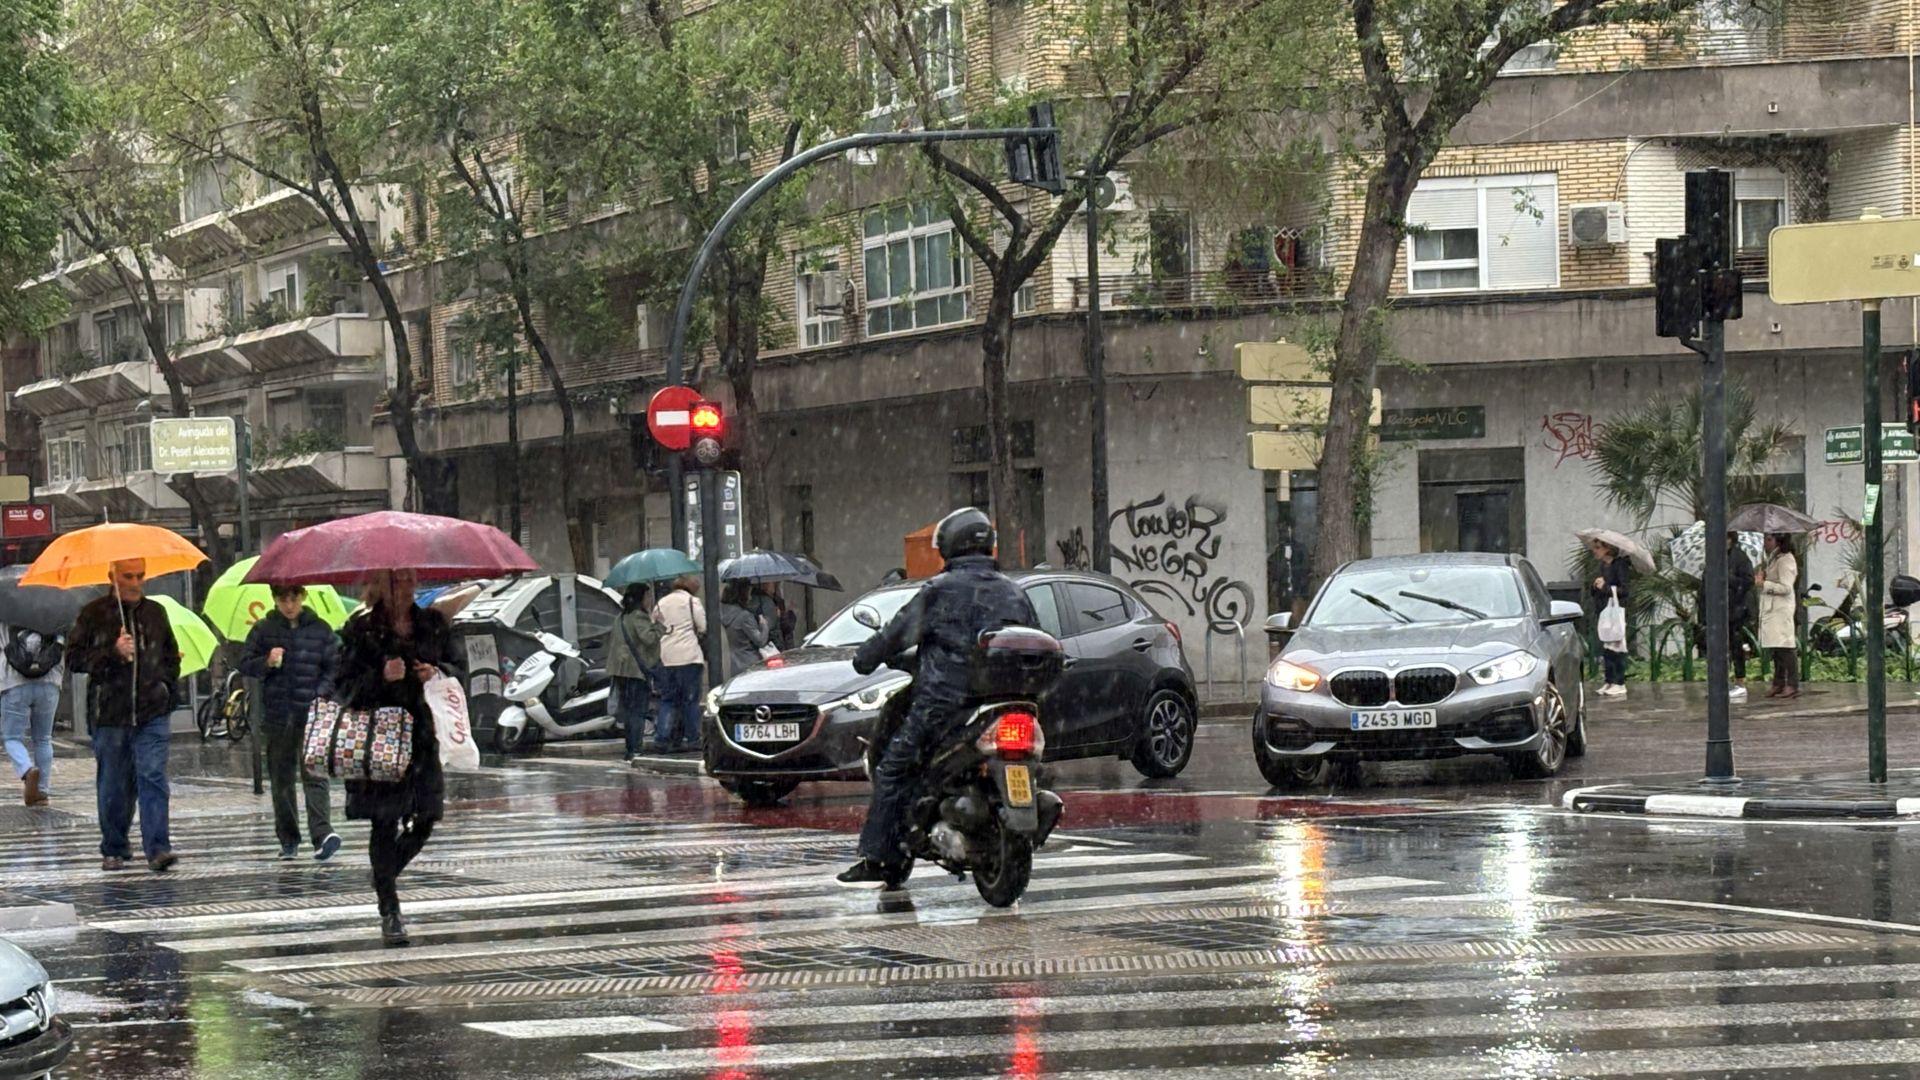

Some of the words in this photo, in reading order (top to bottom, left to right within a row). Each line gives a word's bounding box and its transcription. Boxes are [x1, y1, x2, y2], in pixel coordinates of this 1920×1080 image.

[1436, 411, 1467, 425] VLC
[178, 426, 215, 440] Avinguda
[215, 423, 228, 437] del
[1361, 712, 1398, 728] 2453
[1403, 711, 1432, 726] MGD
[743, 724, 771, 739] 8764
[774, 723, 797, 739] LBH
